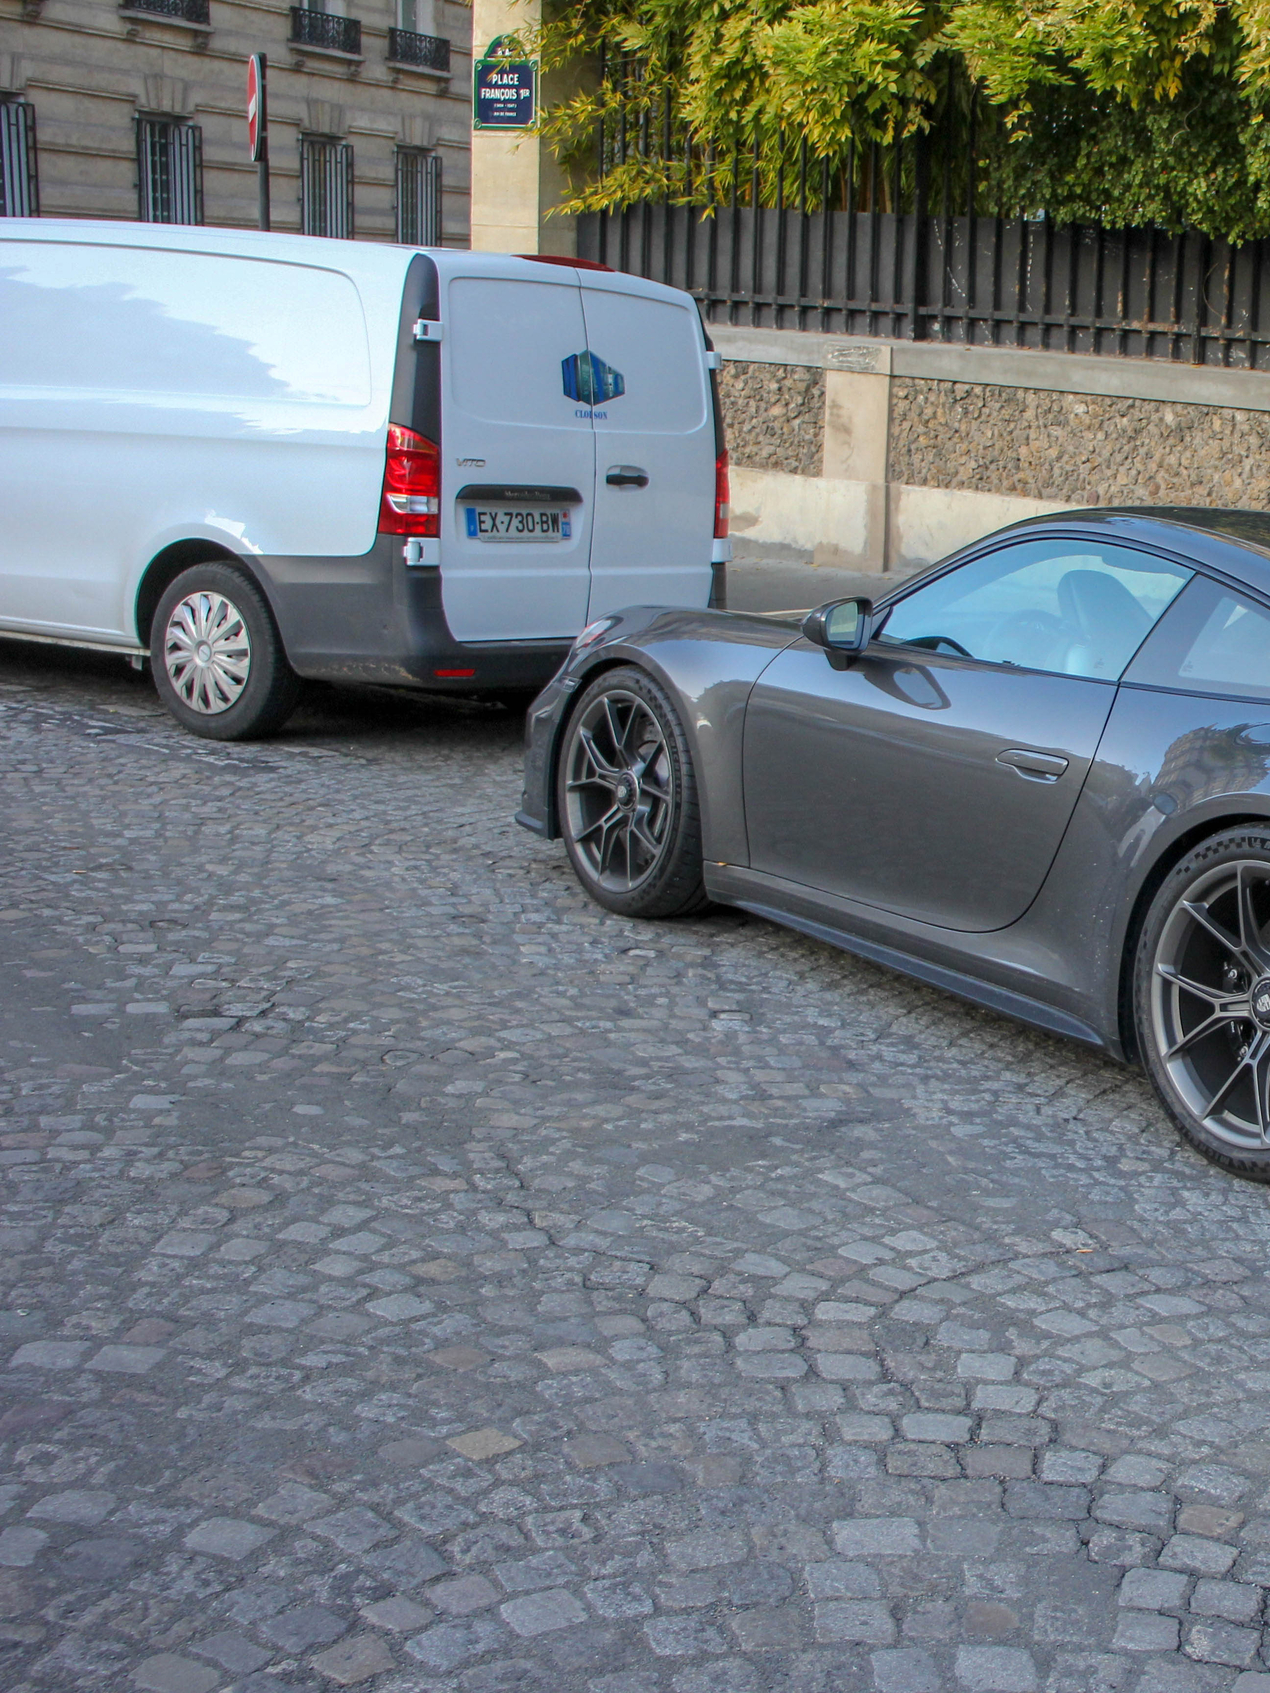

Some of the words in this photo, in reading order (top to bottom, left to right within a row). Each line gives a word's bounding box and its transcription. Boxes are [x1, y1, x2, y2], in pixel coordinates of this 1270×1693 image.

[492, 74, 520, 85] PLACE
[480, 88, 518, 101] FRANÇOIS
[456, 458, 486, 468] VITO
[478, 512, 560, 533] EX-730-BW
